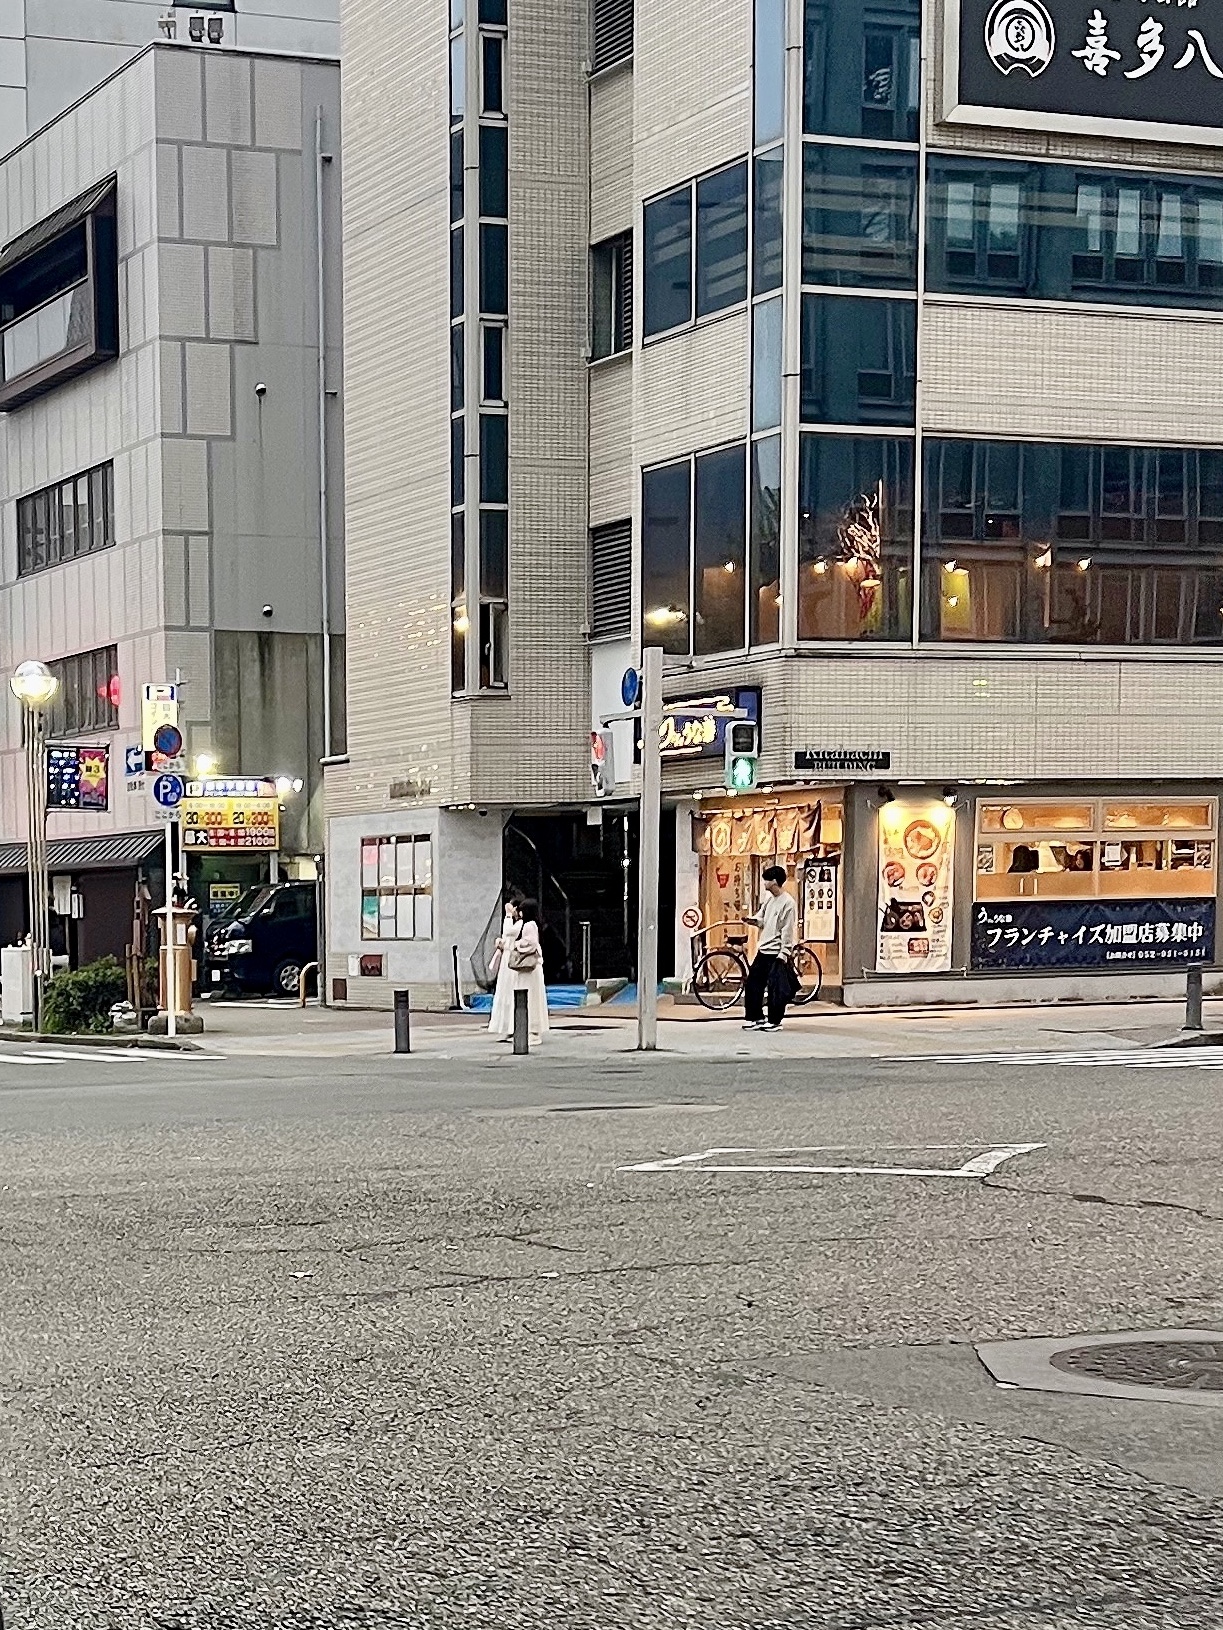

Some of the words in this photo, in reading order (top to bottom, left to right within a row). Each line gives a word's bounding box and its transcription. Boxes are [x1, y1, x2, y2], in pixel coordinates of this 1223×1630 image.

[1071, 9, 1223, 79] 喜多八
[813, 760, 877, 773] BUILDING
[159, 781, 172, 802] P
[986, 921, 1204, 948] フランチャイズ加盟店募集中
